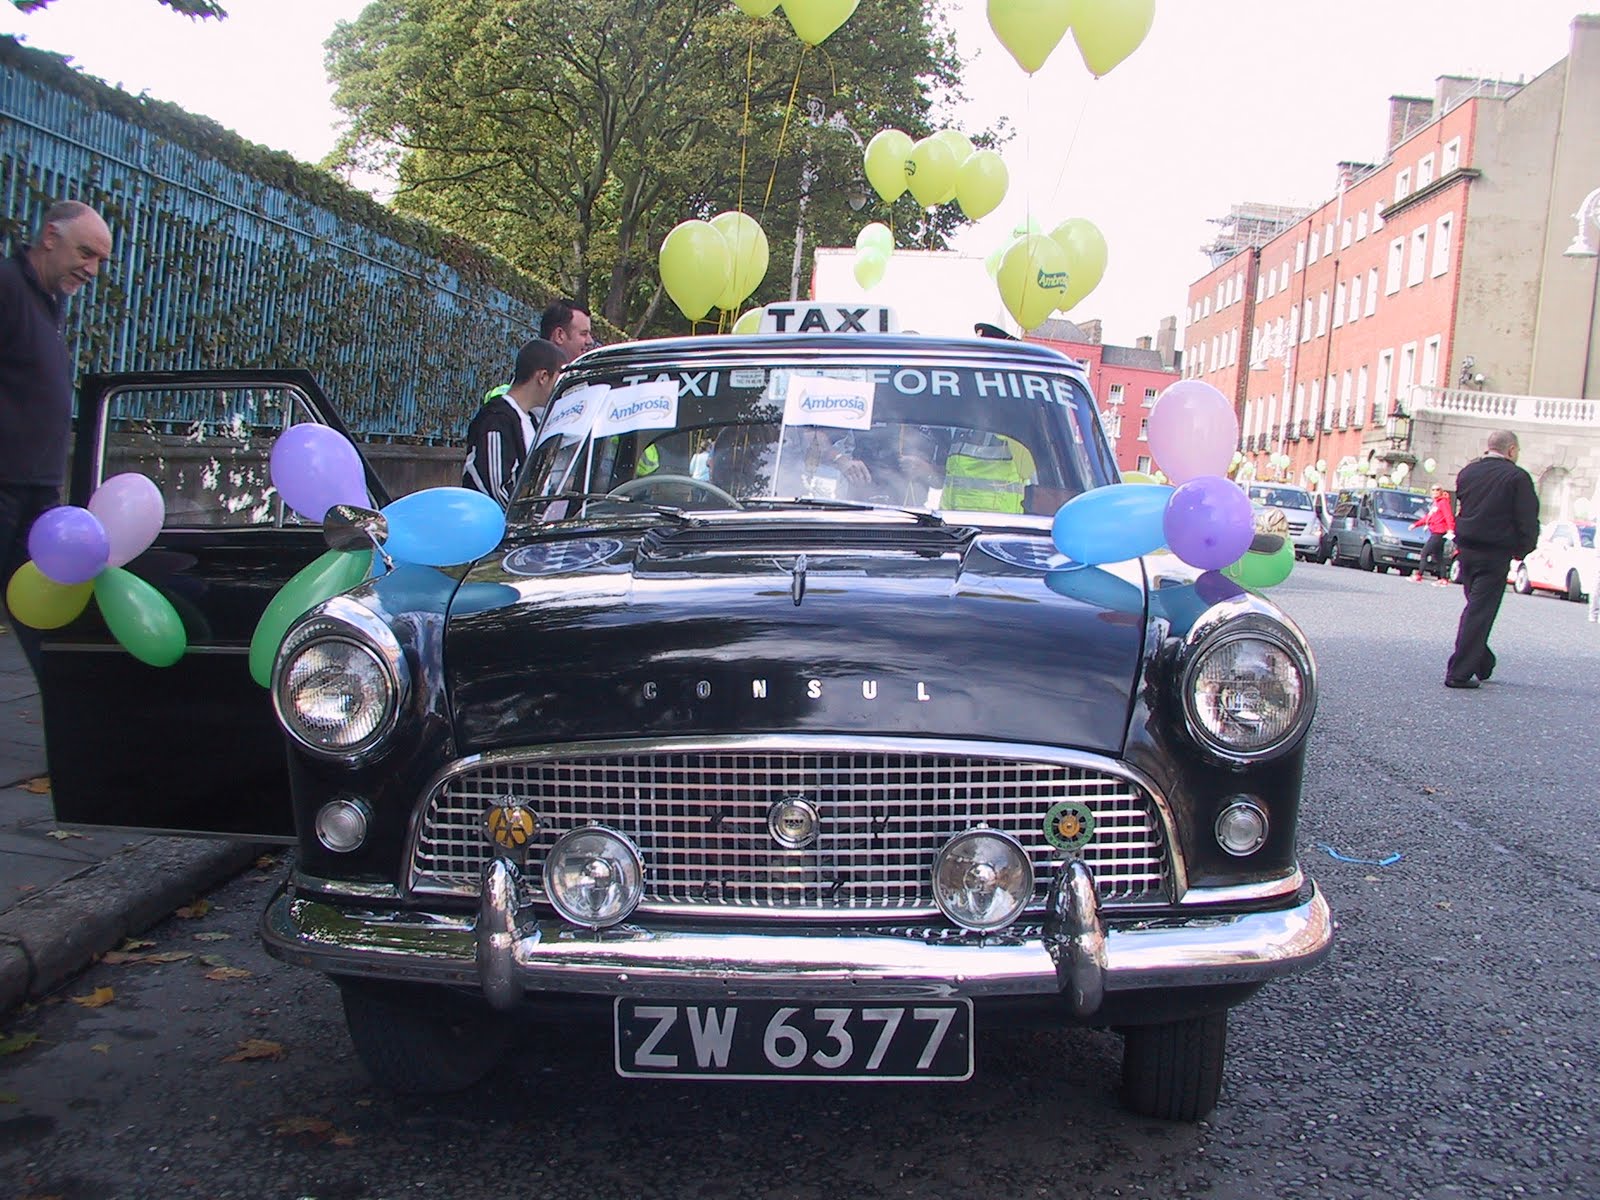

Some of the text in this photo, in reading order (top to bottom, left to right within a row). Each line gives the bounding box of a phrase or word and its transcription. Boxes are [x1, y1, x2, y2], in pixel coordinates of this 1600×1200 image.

[767, 308, 889, 333] TAXI
[866, 368, 961, 397] FOR
[974, 371, 1079, 411] HIRE
[609, 395, 670, 420] Ambrosia
[801, 395, 866, 412] Ambrosia
[642, 679, 931, 701] CONSUL
[633, 1006, 958, 1070] ZW 6377
